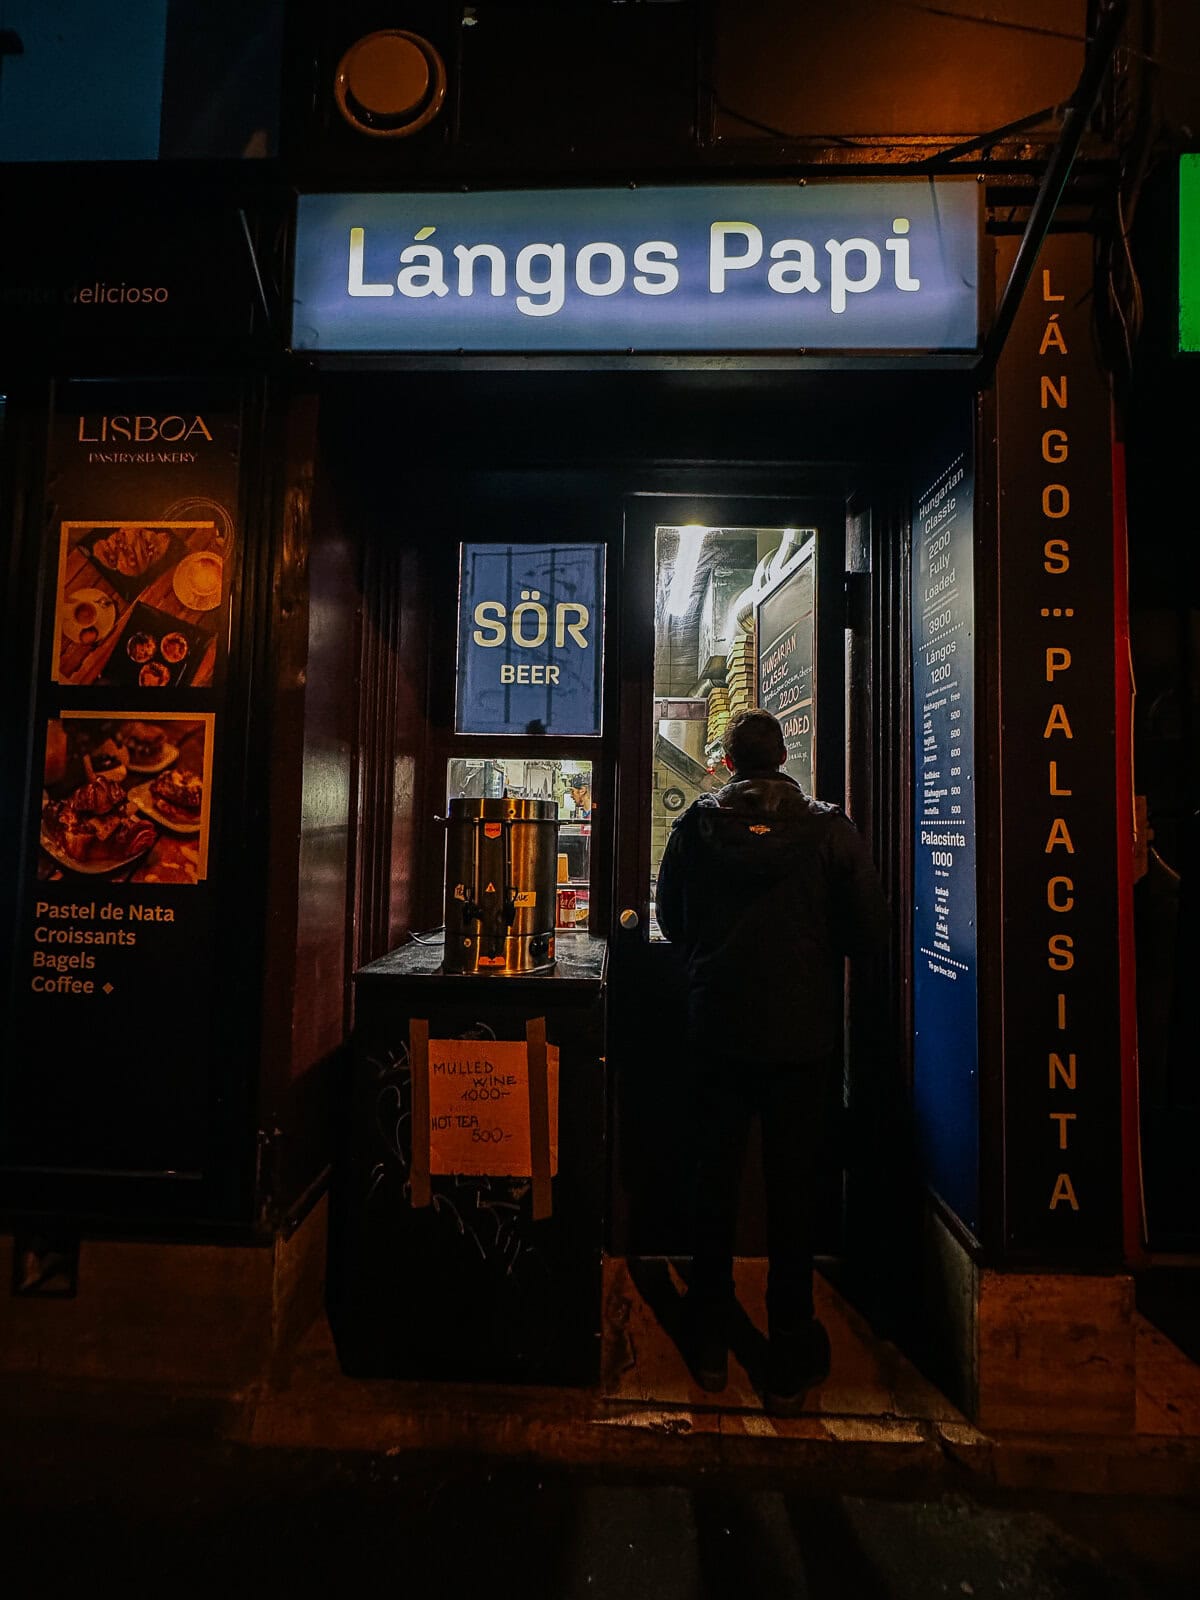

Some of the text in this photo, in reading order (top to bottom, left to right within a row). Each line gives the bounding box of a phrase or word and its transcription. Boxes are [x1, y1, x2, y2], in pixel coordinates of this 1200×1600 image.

[347, 218, 921, 316] Lángos Papi
[78, 415, 213, 442] LISBOA
[1039, 269, 1071, 575] LÁNGOS
[918, 468, 964, 521] Hungarian
[924, 497, 956, 534] Classic
[928, 530, 951, 560] 2200
[929, 552, 951, 578] Fully
[924, 568, 956, 602] Loaded
[473, 590, 590, 649] SÖR
[928, 609, 951, 634] 3900
[762, 632, 797, 678] HUNGARIAN
[926, 640, 956, 666] Lángos
[500, 664, 560, 685] BEER
[762, 662, 789, 694] CLASSIC
[930, 663, 951, 684] 1200
[783, 715, 809, 738] OADED
[921, 830, 966, 847] Palacsinta
[931, 851, 953, 867] 1000
[35, 902, 175, 922] Pastel de Nata
[34, 926, 137, 946] Croissants
[1043, 647, 1080, 1211] PALACSINTA
[32, 951, 96, 972] Bagels
[31, 976, 94, 994] Coffee
[433, 1062, 494, 1075] MULLED
[473, 1075, 518, 1087] WINE
[431, 1115, 479, 1130] HOT TEA
